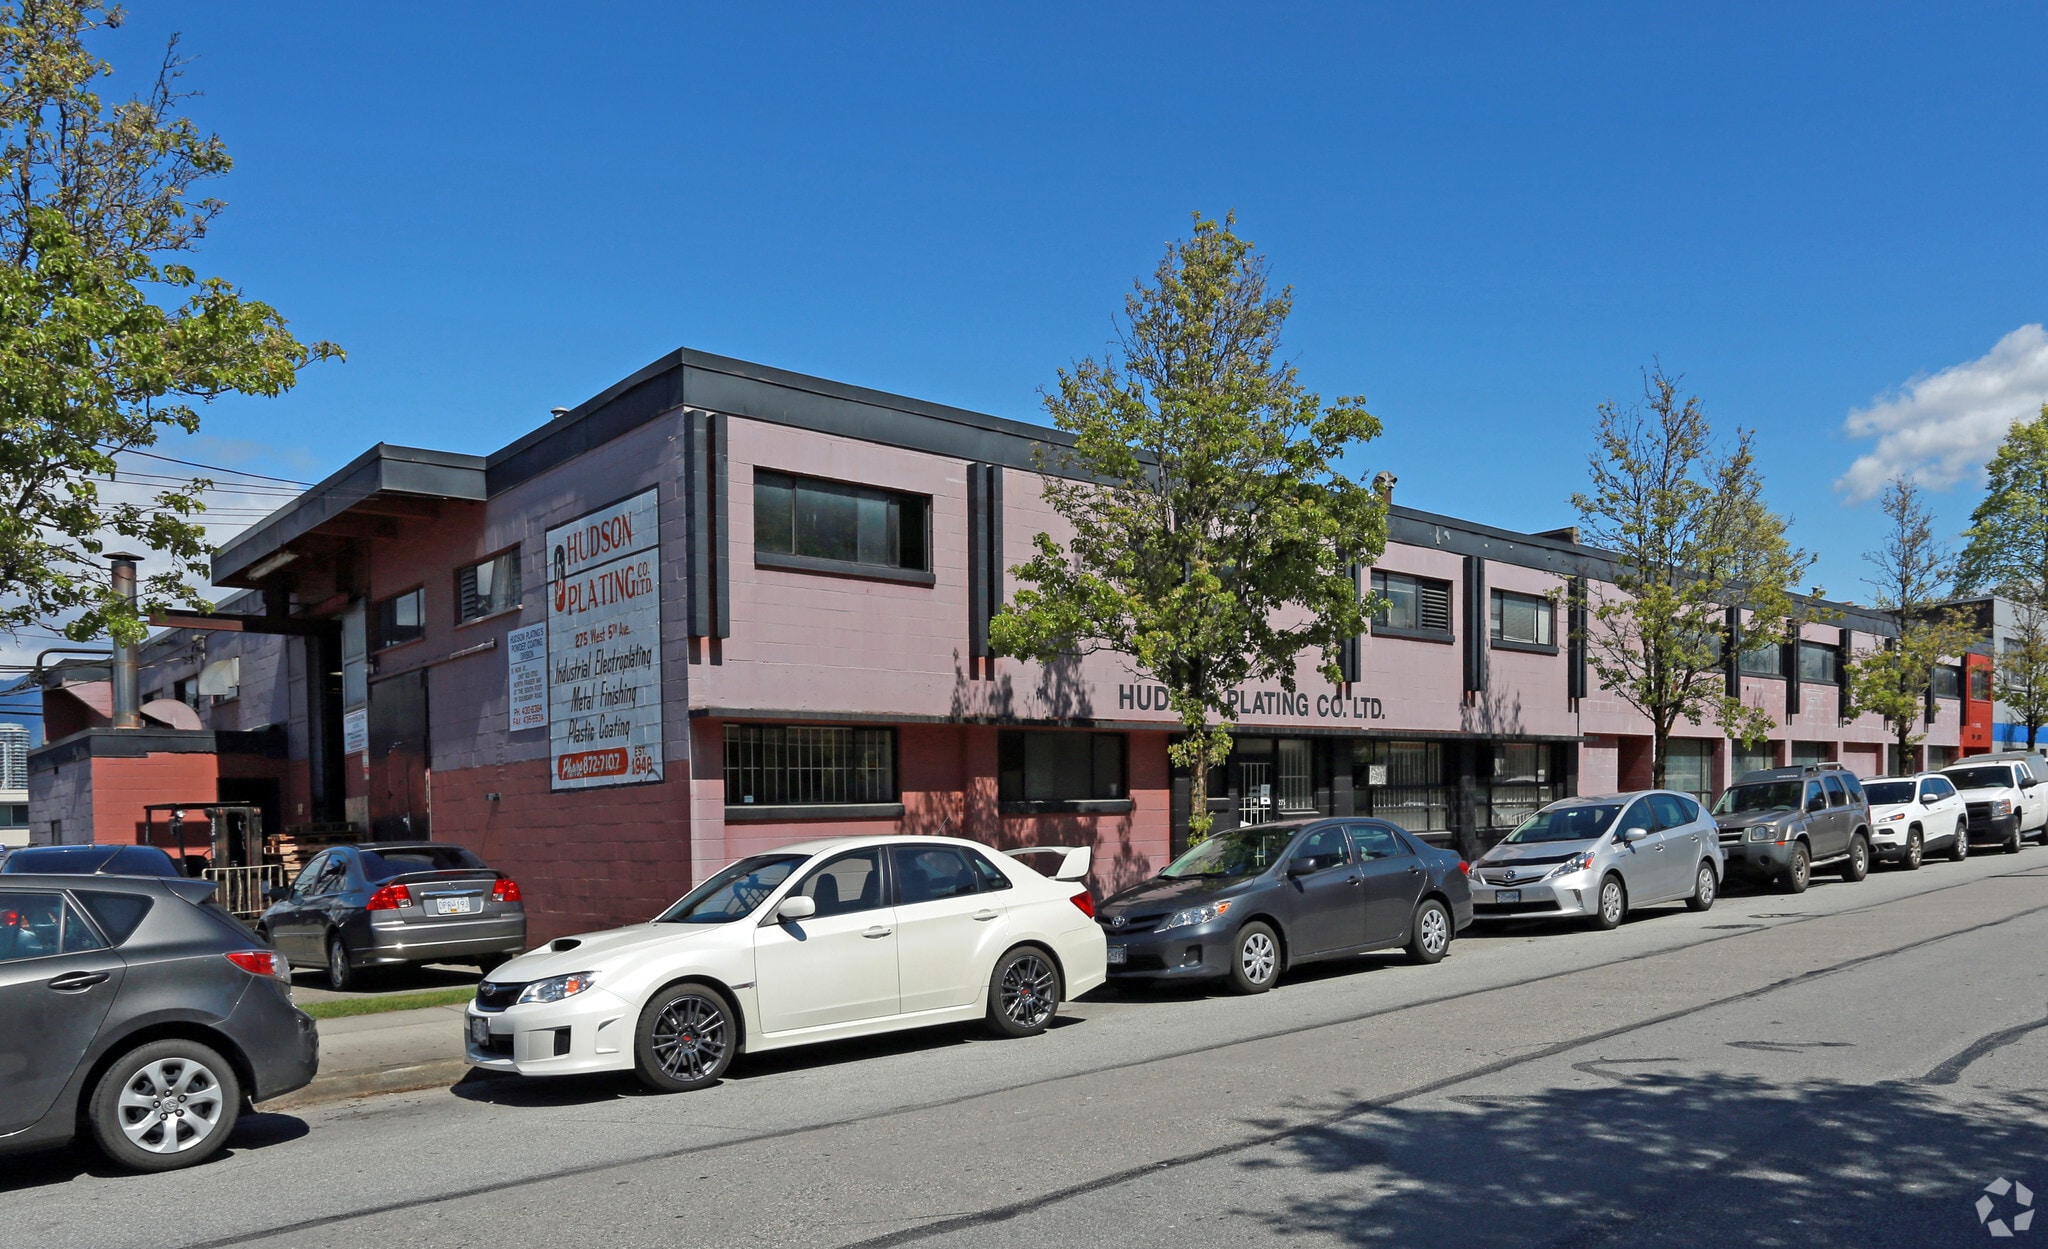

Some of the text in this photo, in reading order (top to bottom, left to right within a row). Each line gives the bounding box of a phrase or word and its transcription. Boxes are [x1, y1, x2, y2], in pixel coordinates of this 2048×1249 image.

[567, 512, 632, 566] HUDSON
[638, 562, 650, 578] CO.
[568, 566, 635, 616] PLATING
[636, 578, 653, 596] LTD.
[575, 632, 588, 648] 275
[590, 626, 605, 644] West
[555, 643, 652, 684] Industrial Electroplating
[571, 678, 637, 712] Metal Finishing
[1227, 690, 1308, 717] PLATING
[1316, 694, 1347, 718] CO.
[1354, 696, 1386, 720] LTD.
[568, 714, 630, 744] Plastic Coating
[632, 756, 652, 774] 1948
[635, 746, 646, 756] EST.
